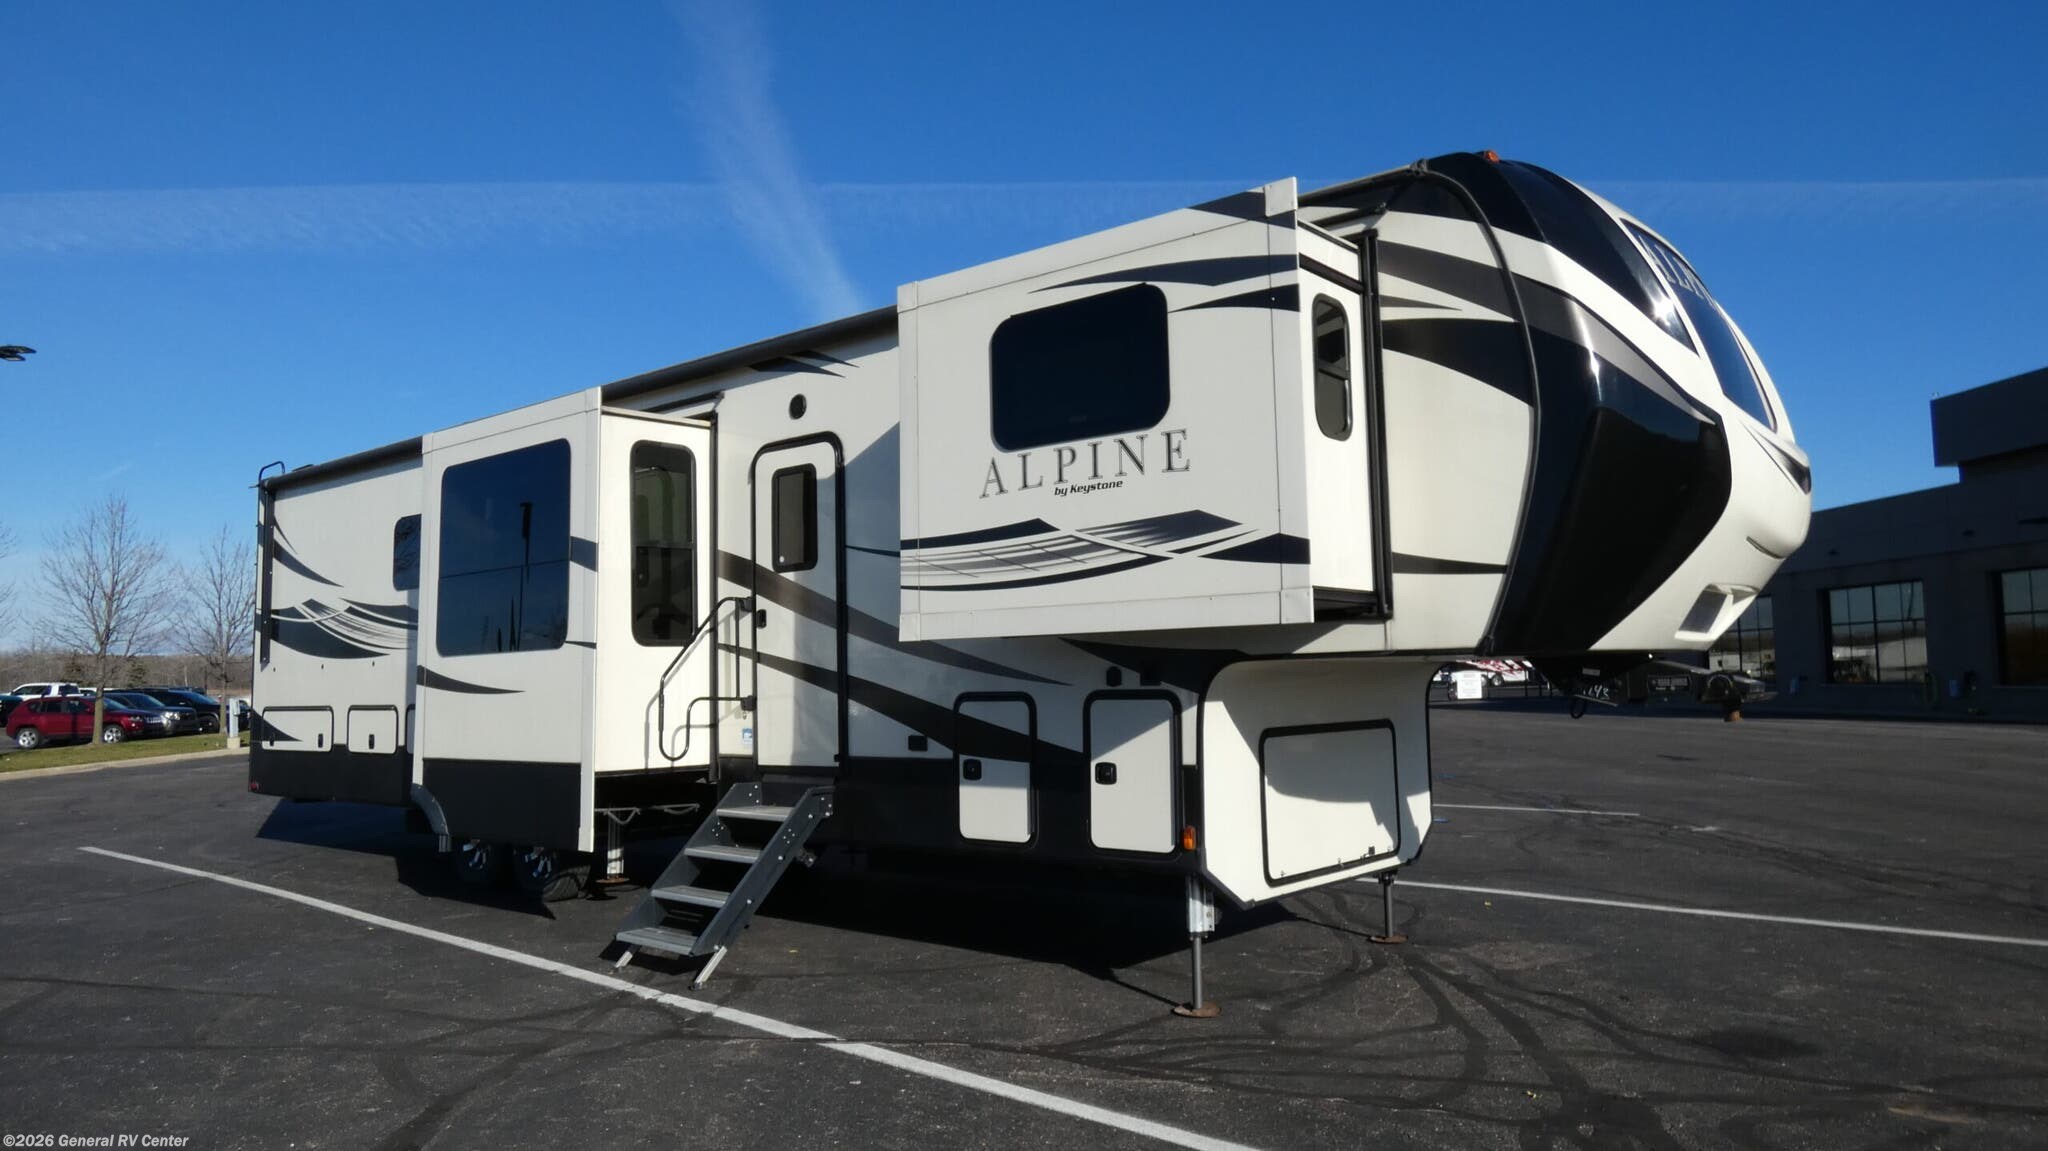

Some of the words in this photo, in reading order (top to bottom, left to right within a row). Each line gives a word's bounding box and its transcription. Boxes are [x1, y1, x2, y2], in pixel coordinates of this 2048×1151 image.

[979, 428, 1191, 499] ALPINE
[1054, 486, 1068, 497] by
[1069, 479, 1124, 494] Keystone
